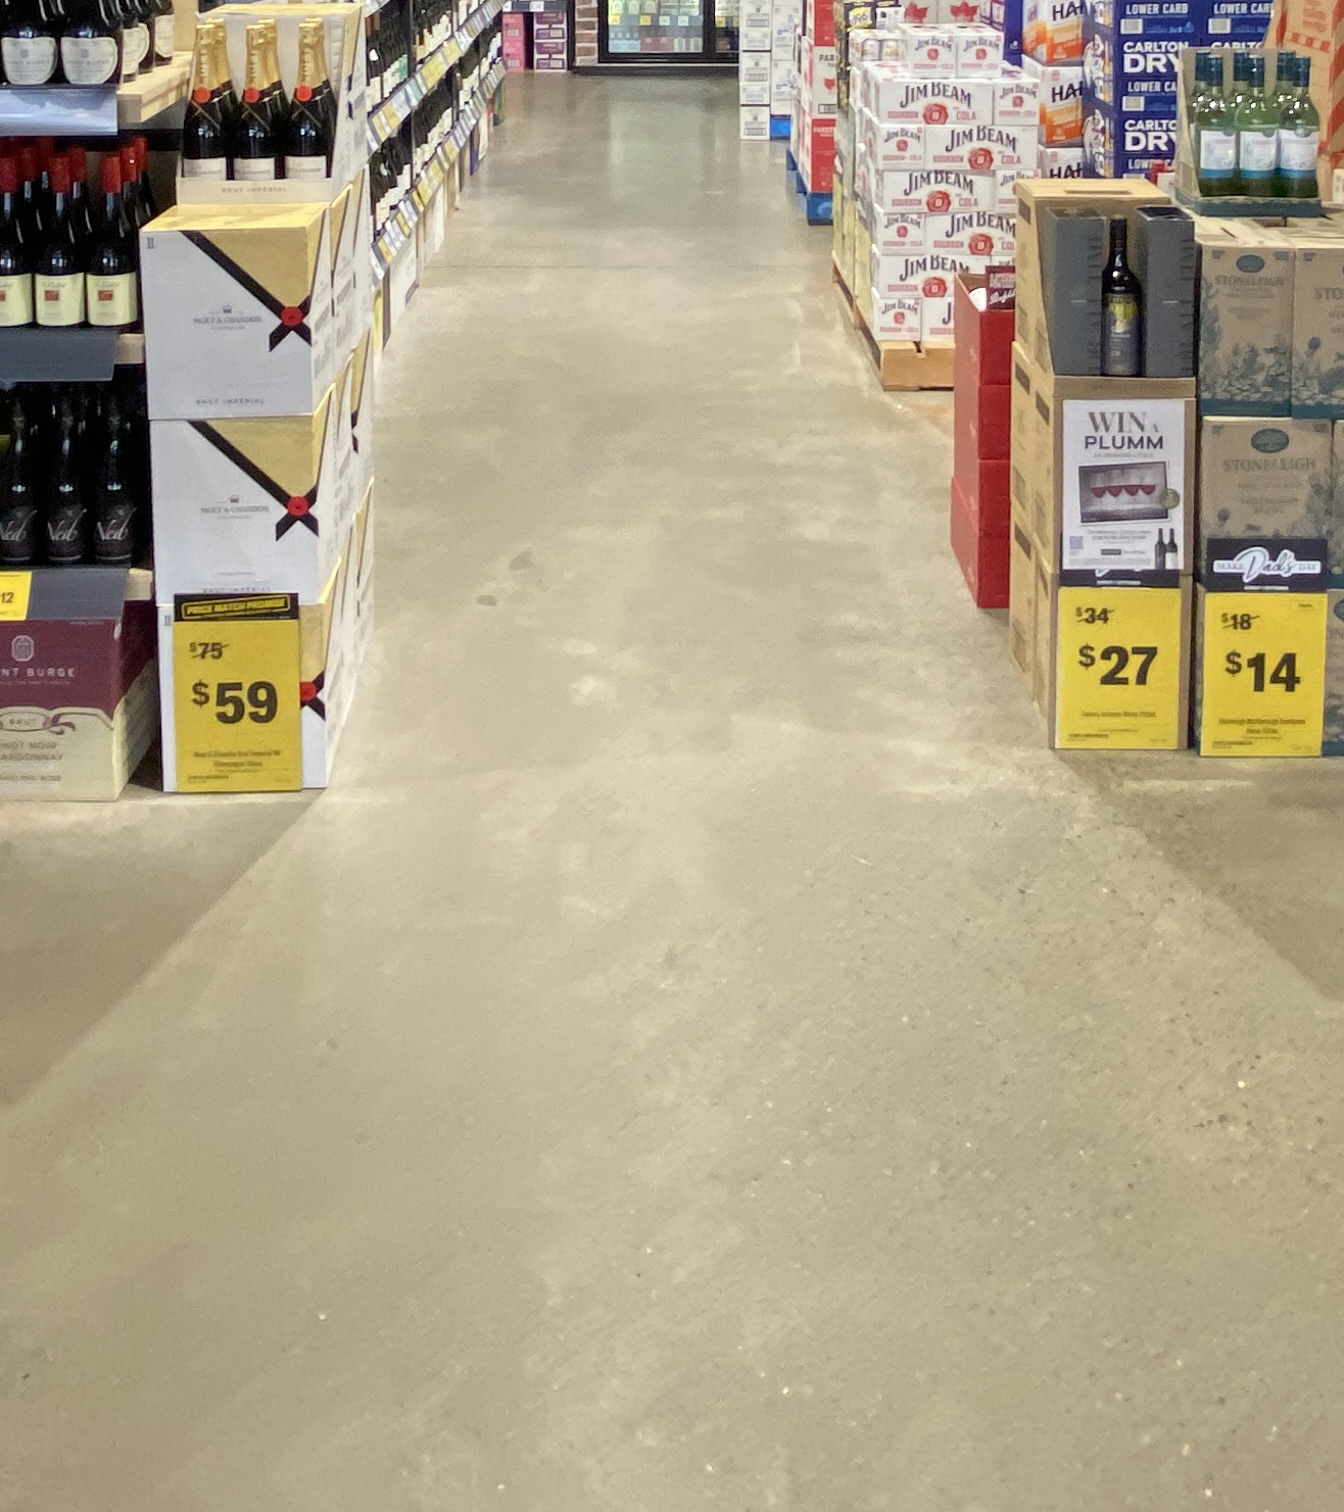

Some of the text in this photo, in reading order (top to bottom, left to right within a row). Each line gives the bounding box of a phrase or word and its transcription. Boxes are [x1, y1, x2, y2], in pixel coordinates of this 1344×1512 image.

[1126, 3, 1188, 15] LOWER CARB
[1214, 3, 1248, 15] LOWER
[1123, 41, 1189, 53] CARLTON
[1128, 81, 1162, 92] LOWER
[900, 81, 972, 109] JIM BEAM
[956, 110, 976, 120] COLA
[884, 127, 921, 143] JIM BEAM
[945, 125, 1017, 153] JIM BEAM
[1001, 155, 1021, 165] COLA
[904, 170, 974, 196] JIM BEAM
[959, 198, 978, 207] COLA
[884, 215, 900, 229] JIM
[945, 215, 973, 237] JIM
[899, 255, 970, 281] JIM BEAM
[1214, 275, 1284, 287] STONELEIGH
[1088, 411, 1147, 433] WIN
[1085, 435, 1164, 450] PLUMM
[1223, 457, 1316, 472] STONELEIGH
[186, 604, 213, 615] PRICE
[214, 601, 245, 612] MATCH
[1078, 643, 1158, 686] $27
[1224, 650, 1301, 693] $14
[26, 668, 75, 677] BURGE
[191, 680, 278, 724] $59
